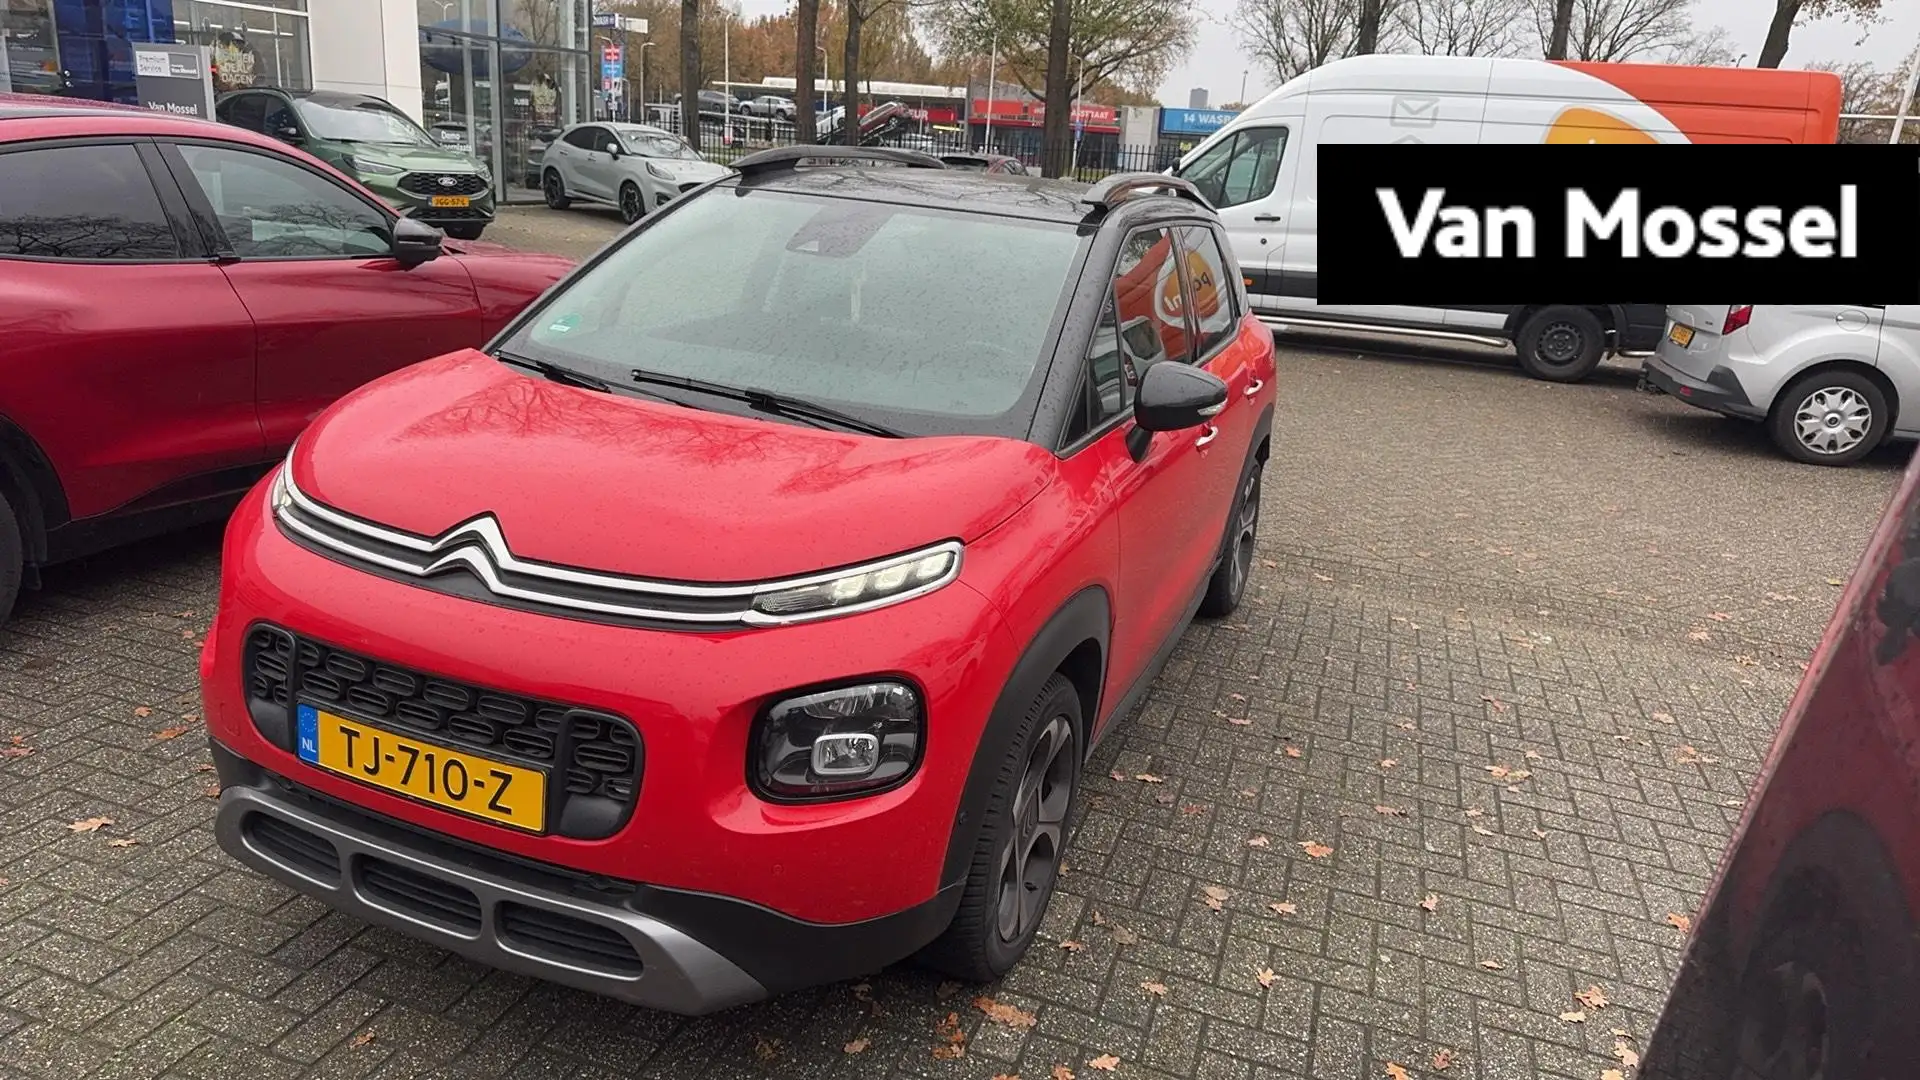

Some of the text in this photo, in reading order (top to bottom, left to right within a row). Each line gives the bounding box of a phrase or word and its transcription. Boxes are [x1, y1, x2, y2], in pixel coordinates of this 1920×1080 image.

[221, 73, 254, 85] DAGEN
[148, 101, 198, 115] Van Mossel
[1183, 112, 1196, 123] 14
[302, 736, 317, 754] NL
[339, 726, 513, 815] TJ-710-Z
